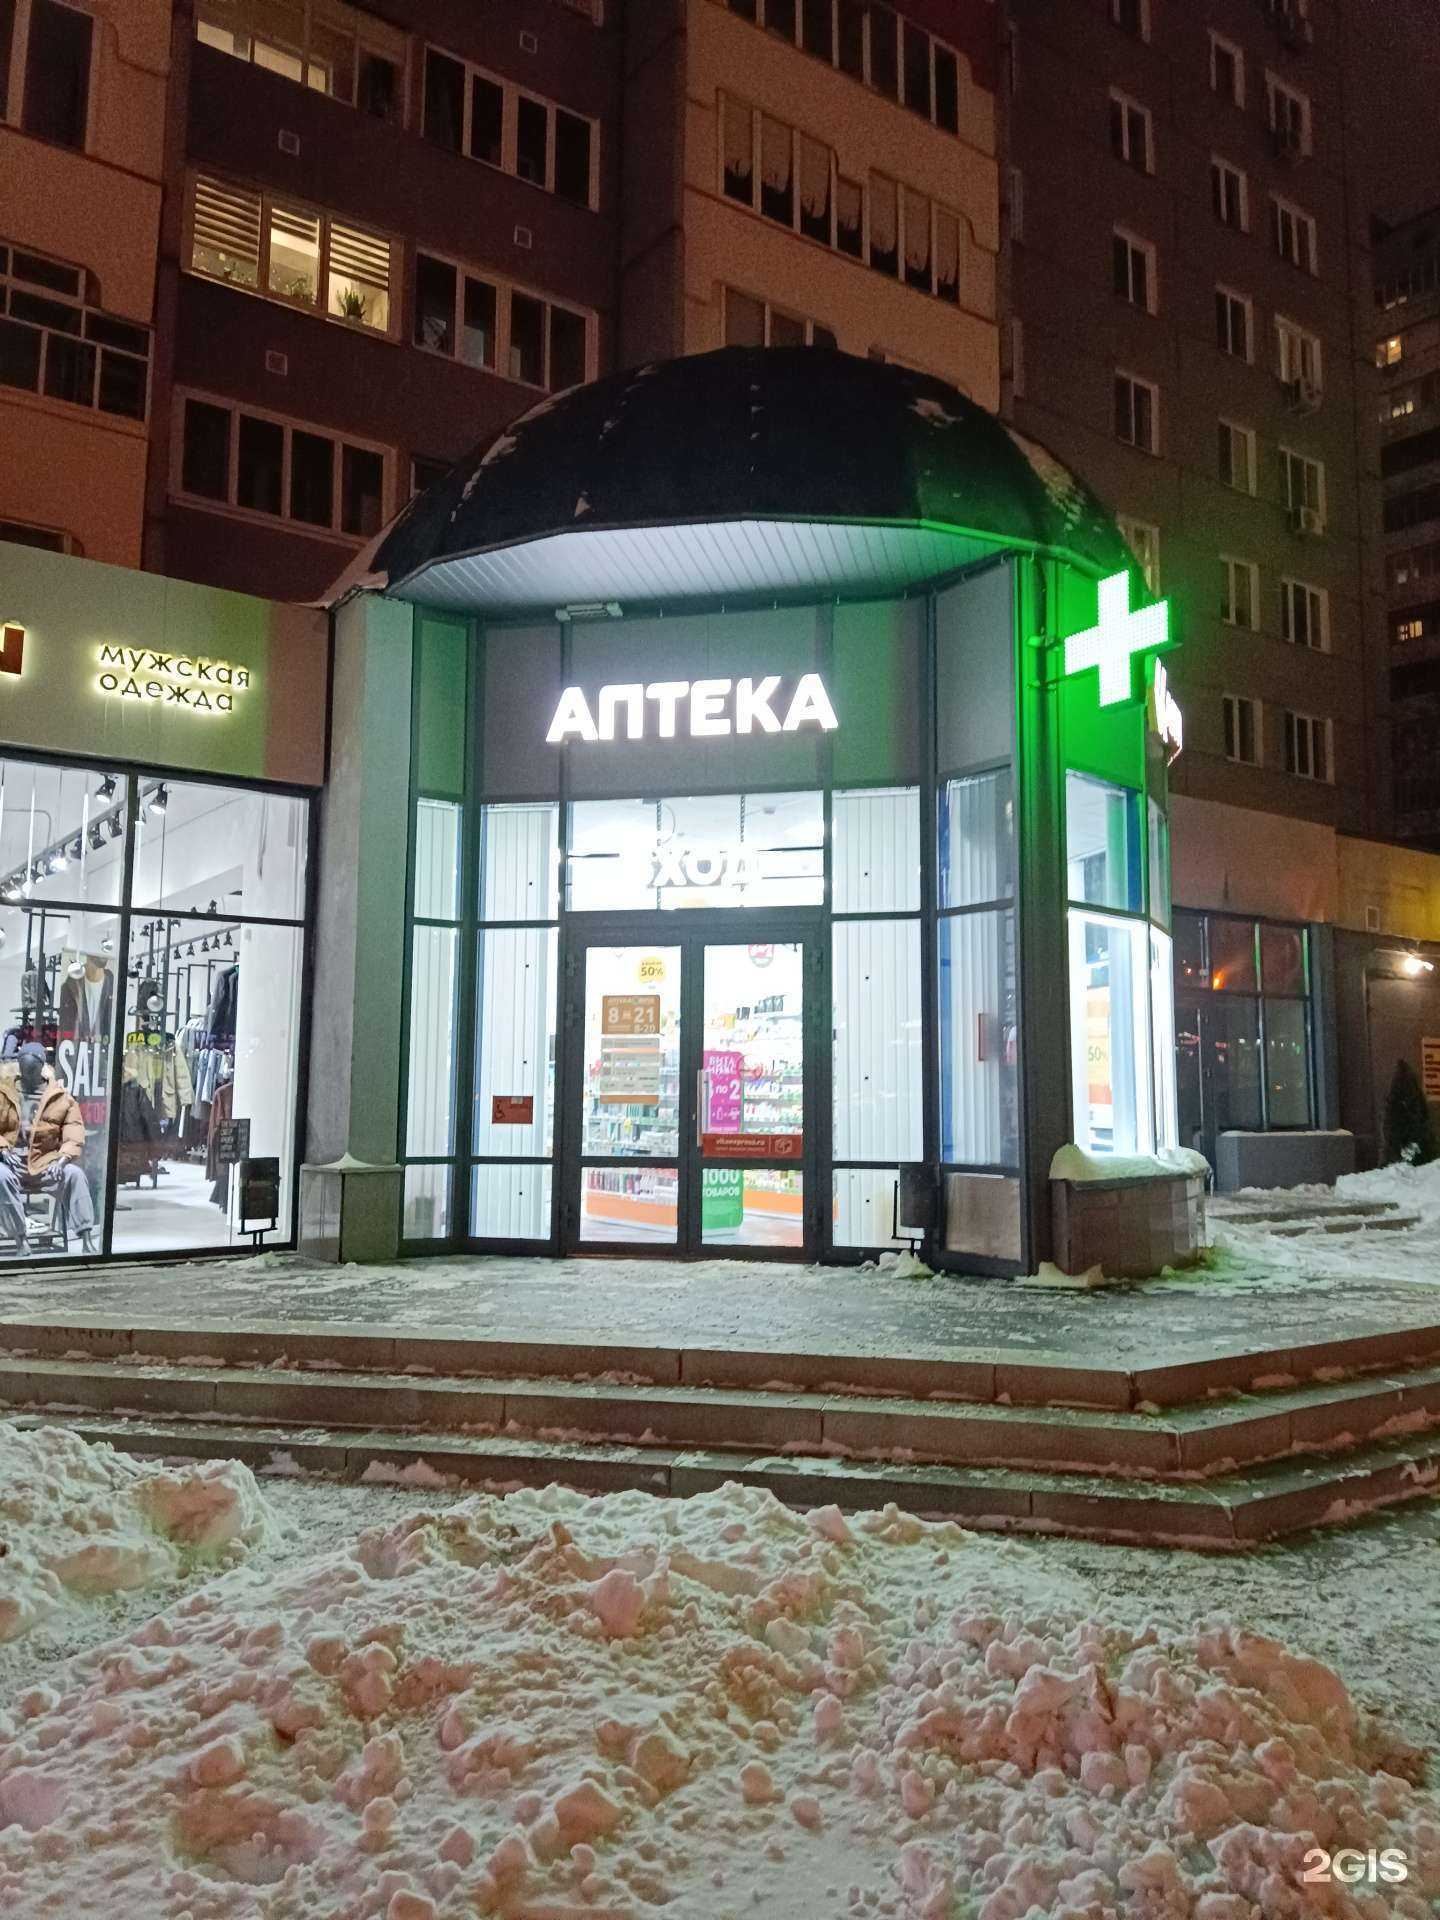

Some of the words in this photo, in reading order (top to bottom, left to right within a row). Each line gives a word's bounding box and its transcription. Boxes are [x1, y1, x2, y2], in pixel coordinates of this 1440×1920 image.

[101, 645, 249, 688] мужская
[100, 673, 233, 711] одежда
[545, 672, 839, 743] АПТЕКА
[637, 848, 762, 889] ХОД
[608, 1006, 619, 1024] 8
[633, 1006, 655, 1024] 21
[59, 1040, 109, 1096] SAL
[729, 1079, 740, 1100] 2
